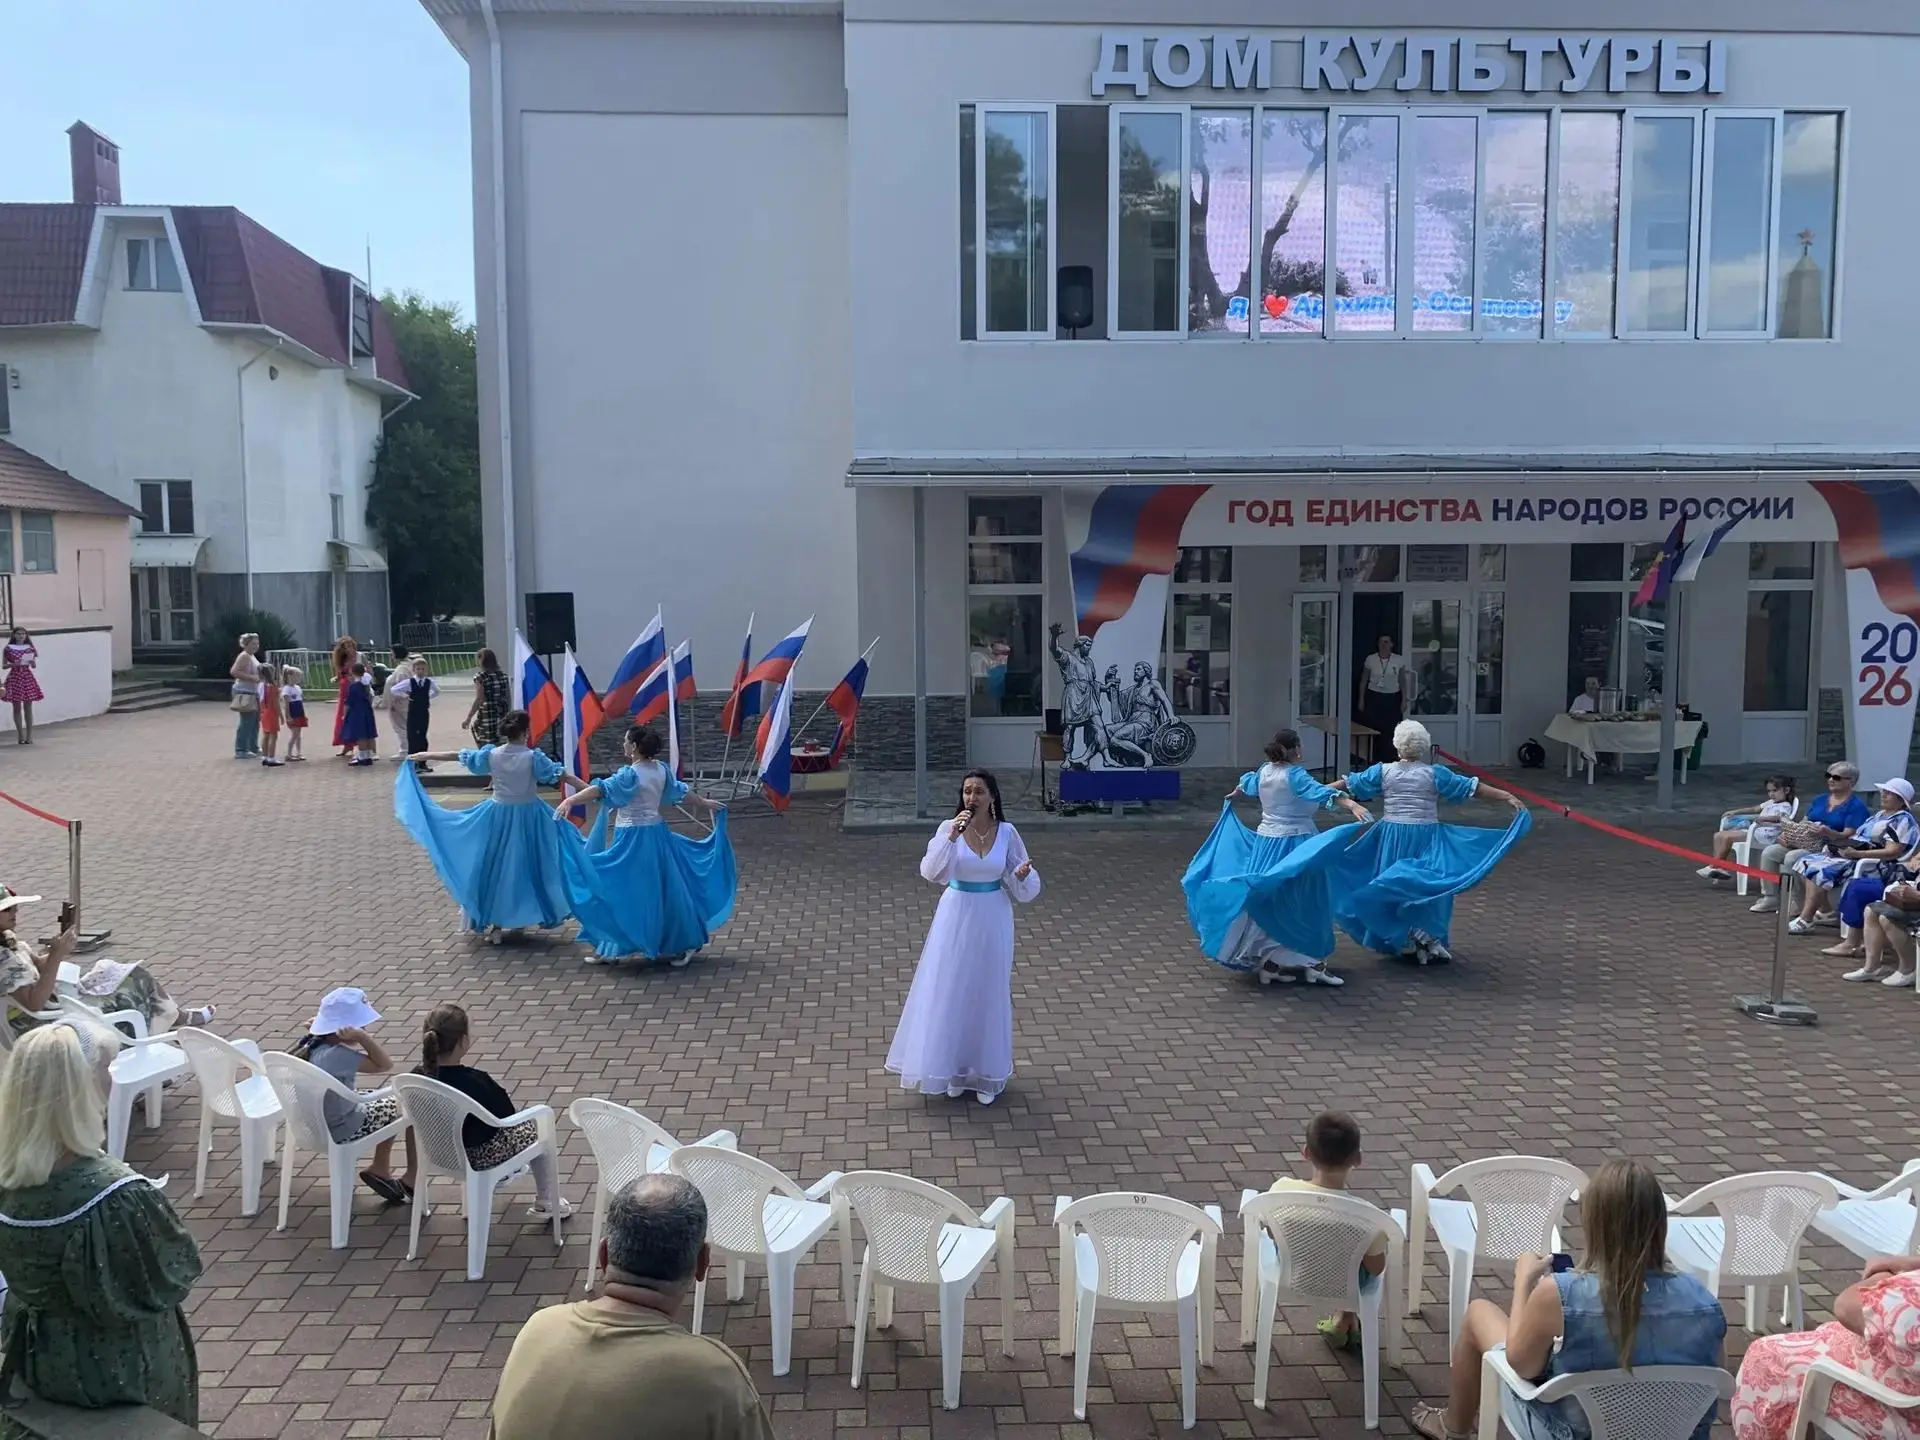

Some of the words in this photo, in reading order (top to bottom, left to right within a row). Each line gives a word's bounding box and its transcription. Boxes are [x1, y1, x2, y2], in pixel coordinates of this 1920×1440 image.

[1091, 33, 1271, 96] ДОМ
[1303, 36, 1726, 94] КУЛЬТУРЫ
[1226, 296, 1250, 321] Я
[1228, 500, 1294, 527] ГОД
[1306, 499, 1483, 525] ЕДИНСТВА
[1491, 497, 1648, 524] НАРОДОВ
[1658, 496, 1794, 521] РОССИИ
[1861, 622, 1918, 663] 20
[1859, 665, 1912, 706] 26
